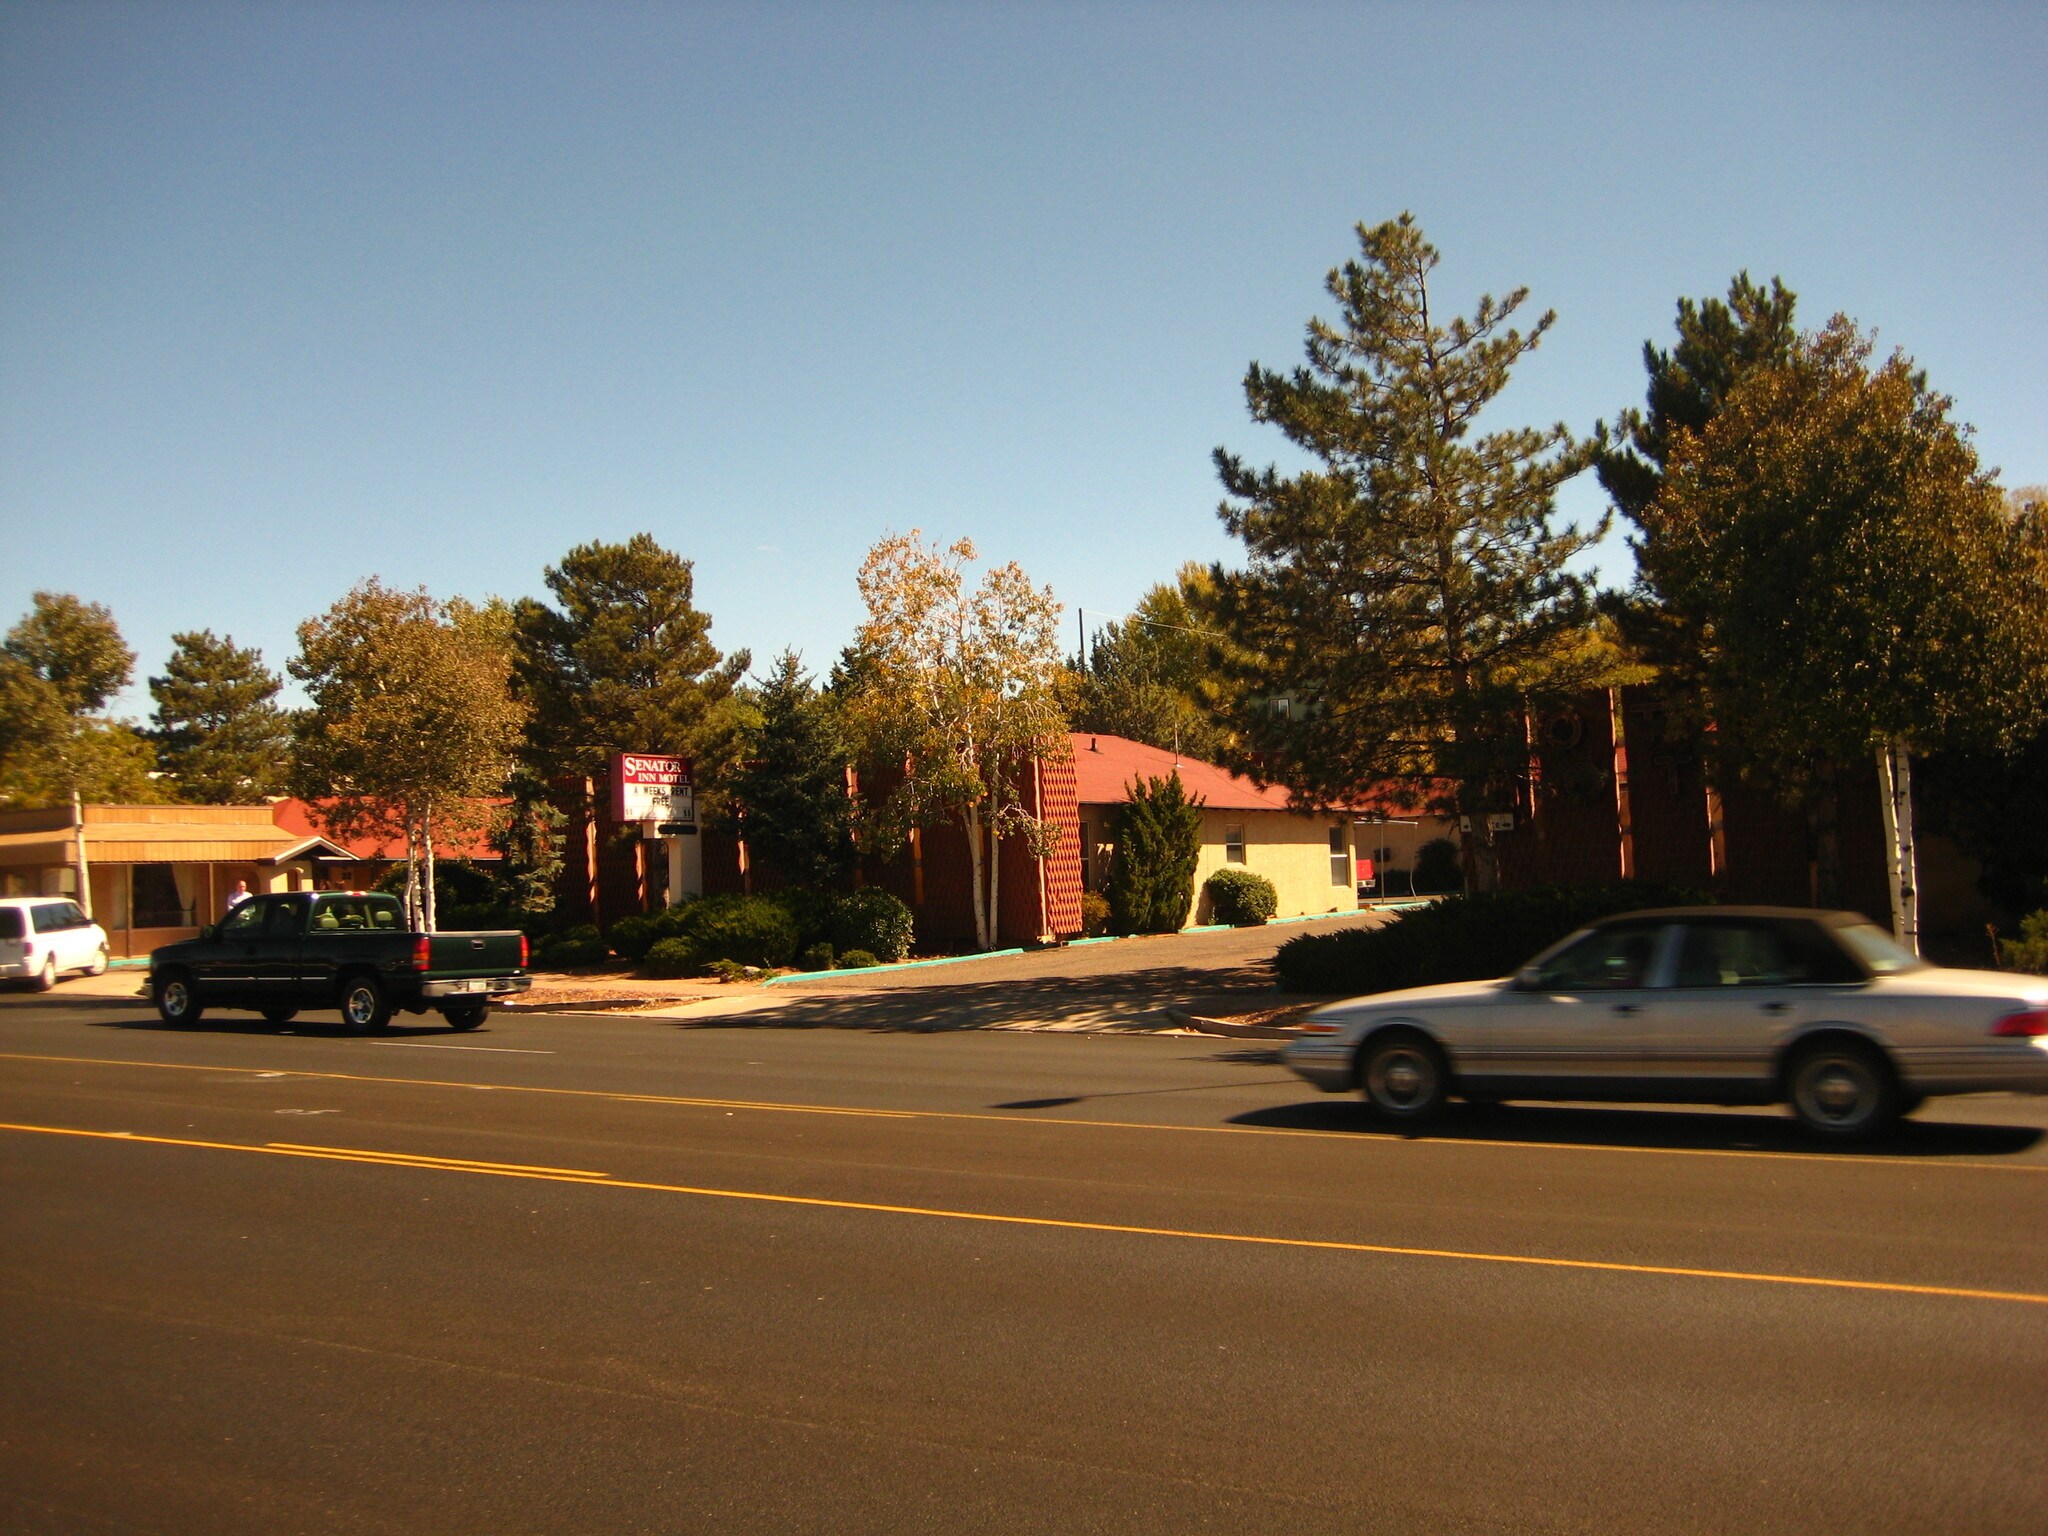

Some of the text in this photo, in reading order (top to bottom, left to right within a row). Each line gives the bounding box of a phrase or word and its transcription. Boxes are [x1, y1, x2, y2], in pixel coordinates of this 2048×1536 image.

[625, 757, 681, 776] SENATOR
[638, 773, 690, 783] INN MOTEL
[634, 786, 688, 796] A WEEKS RENT
[653, 797, 670, 806] FREE
